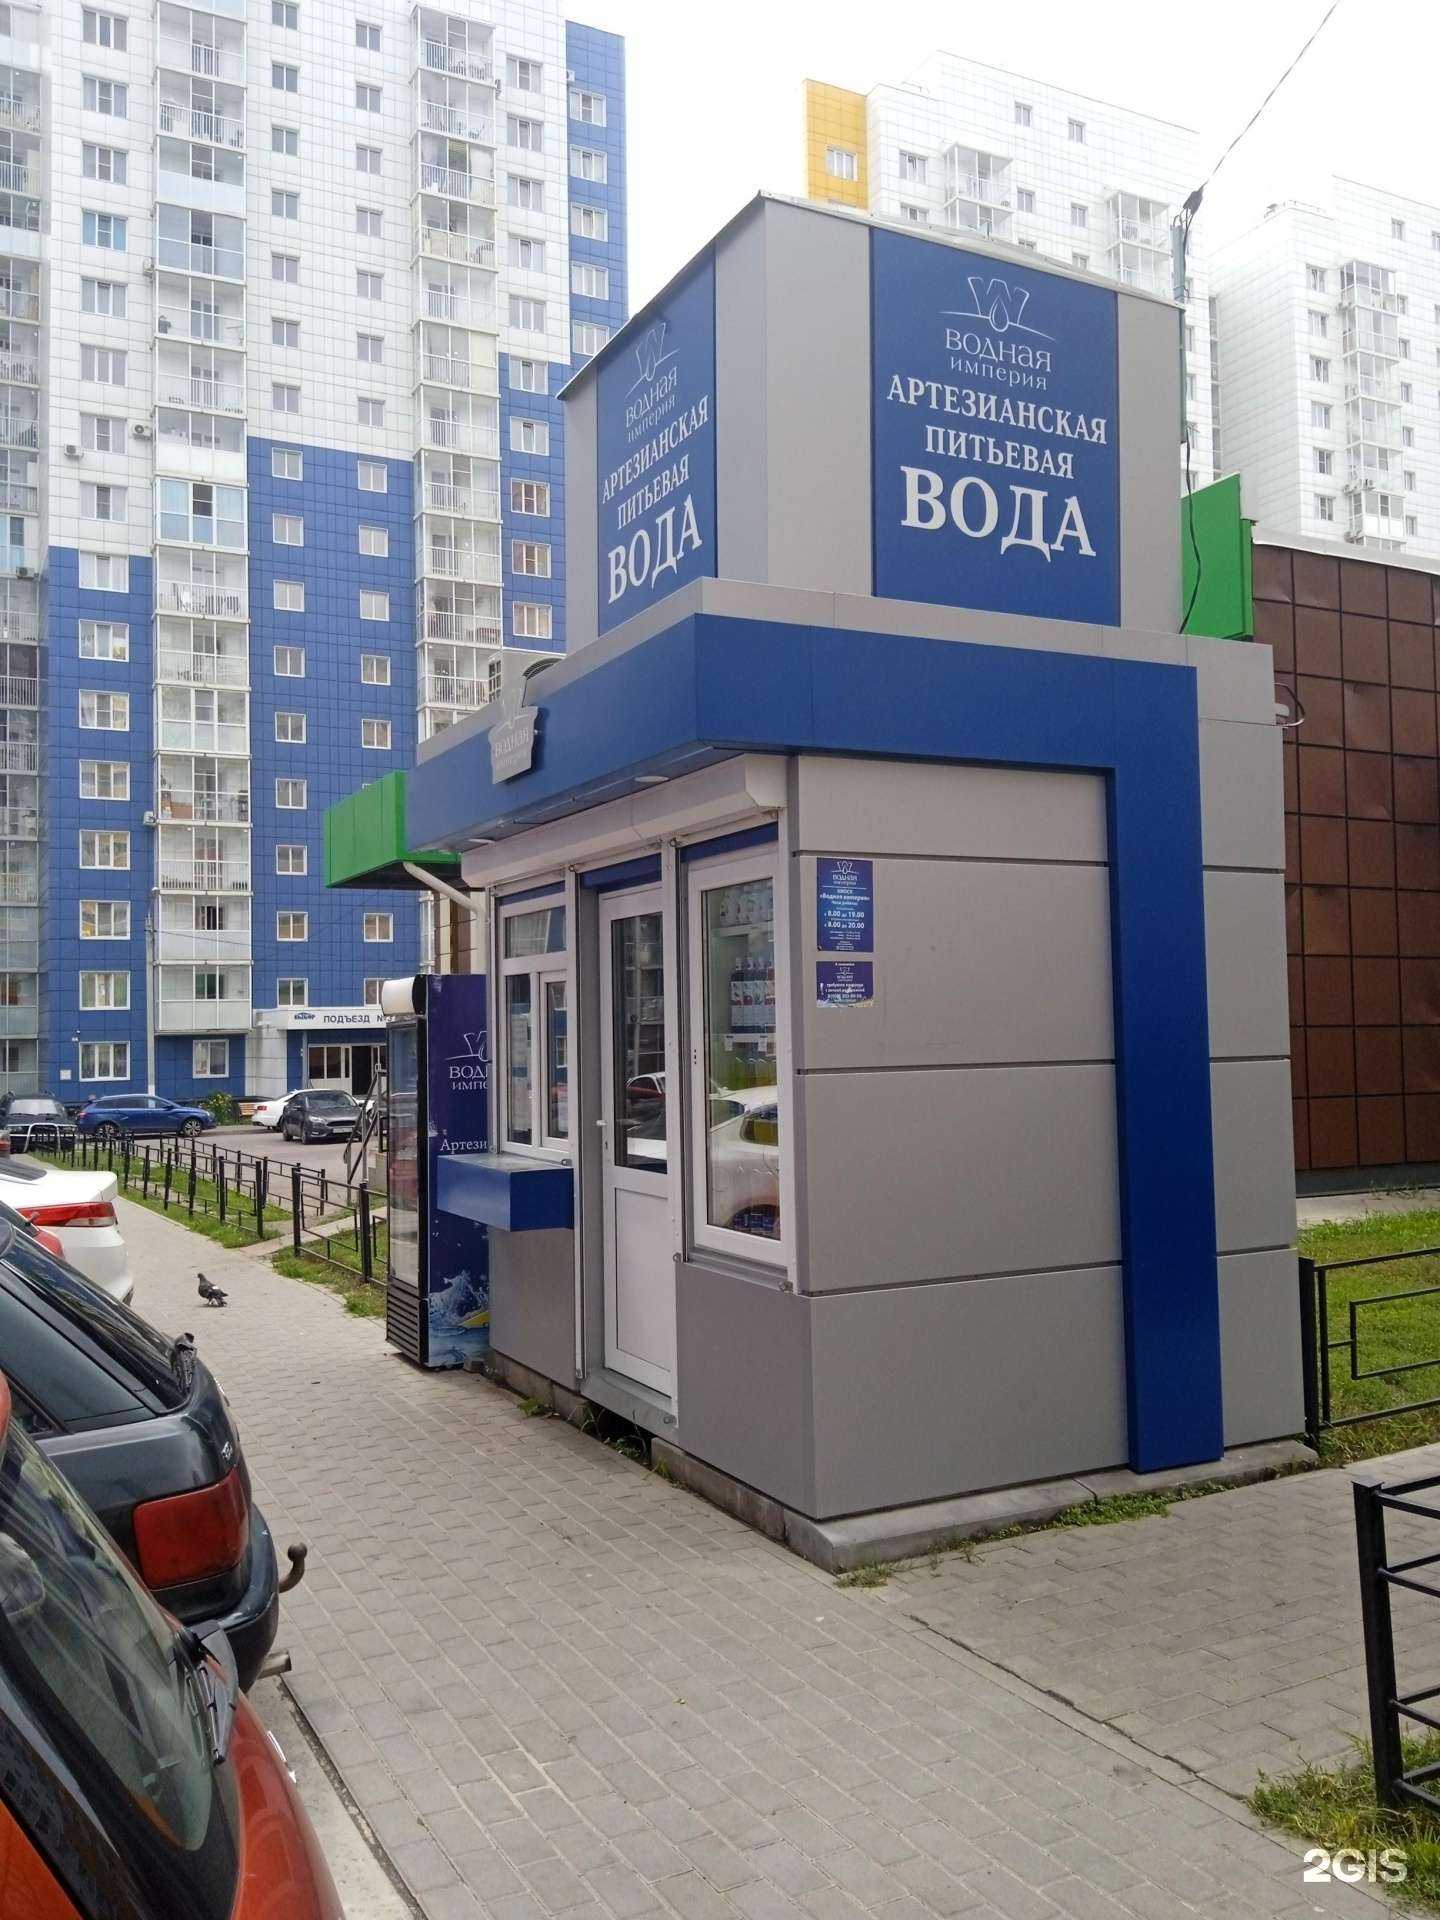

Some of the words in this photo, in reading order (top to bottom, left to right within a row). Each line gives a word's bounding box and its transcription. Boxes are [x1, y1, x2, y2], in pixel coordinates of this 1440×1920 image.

[887, 374, 1107, 445] АРТЕЗИАНСКАЯ
[950, 356, 1048, 391] империя
[602, 394, 709, 505] АРТЕЗИАНСКАЯ
[925, 425, 1075, 480] ПИТЬЕВАЯ
[617, 454, 690, 530] ПИТЬЕВАЯ
[900, 465, 1097, 562] ВОДА
[608, 494, 703, 605] ВОДА
[323, 1015, 371, 1024] ПОДЪЕЗД
